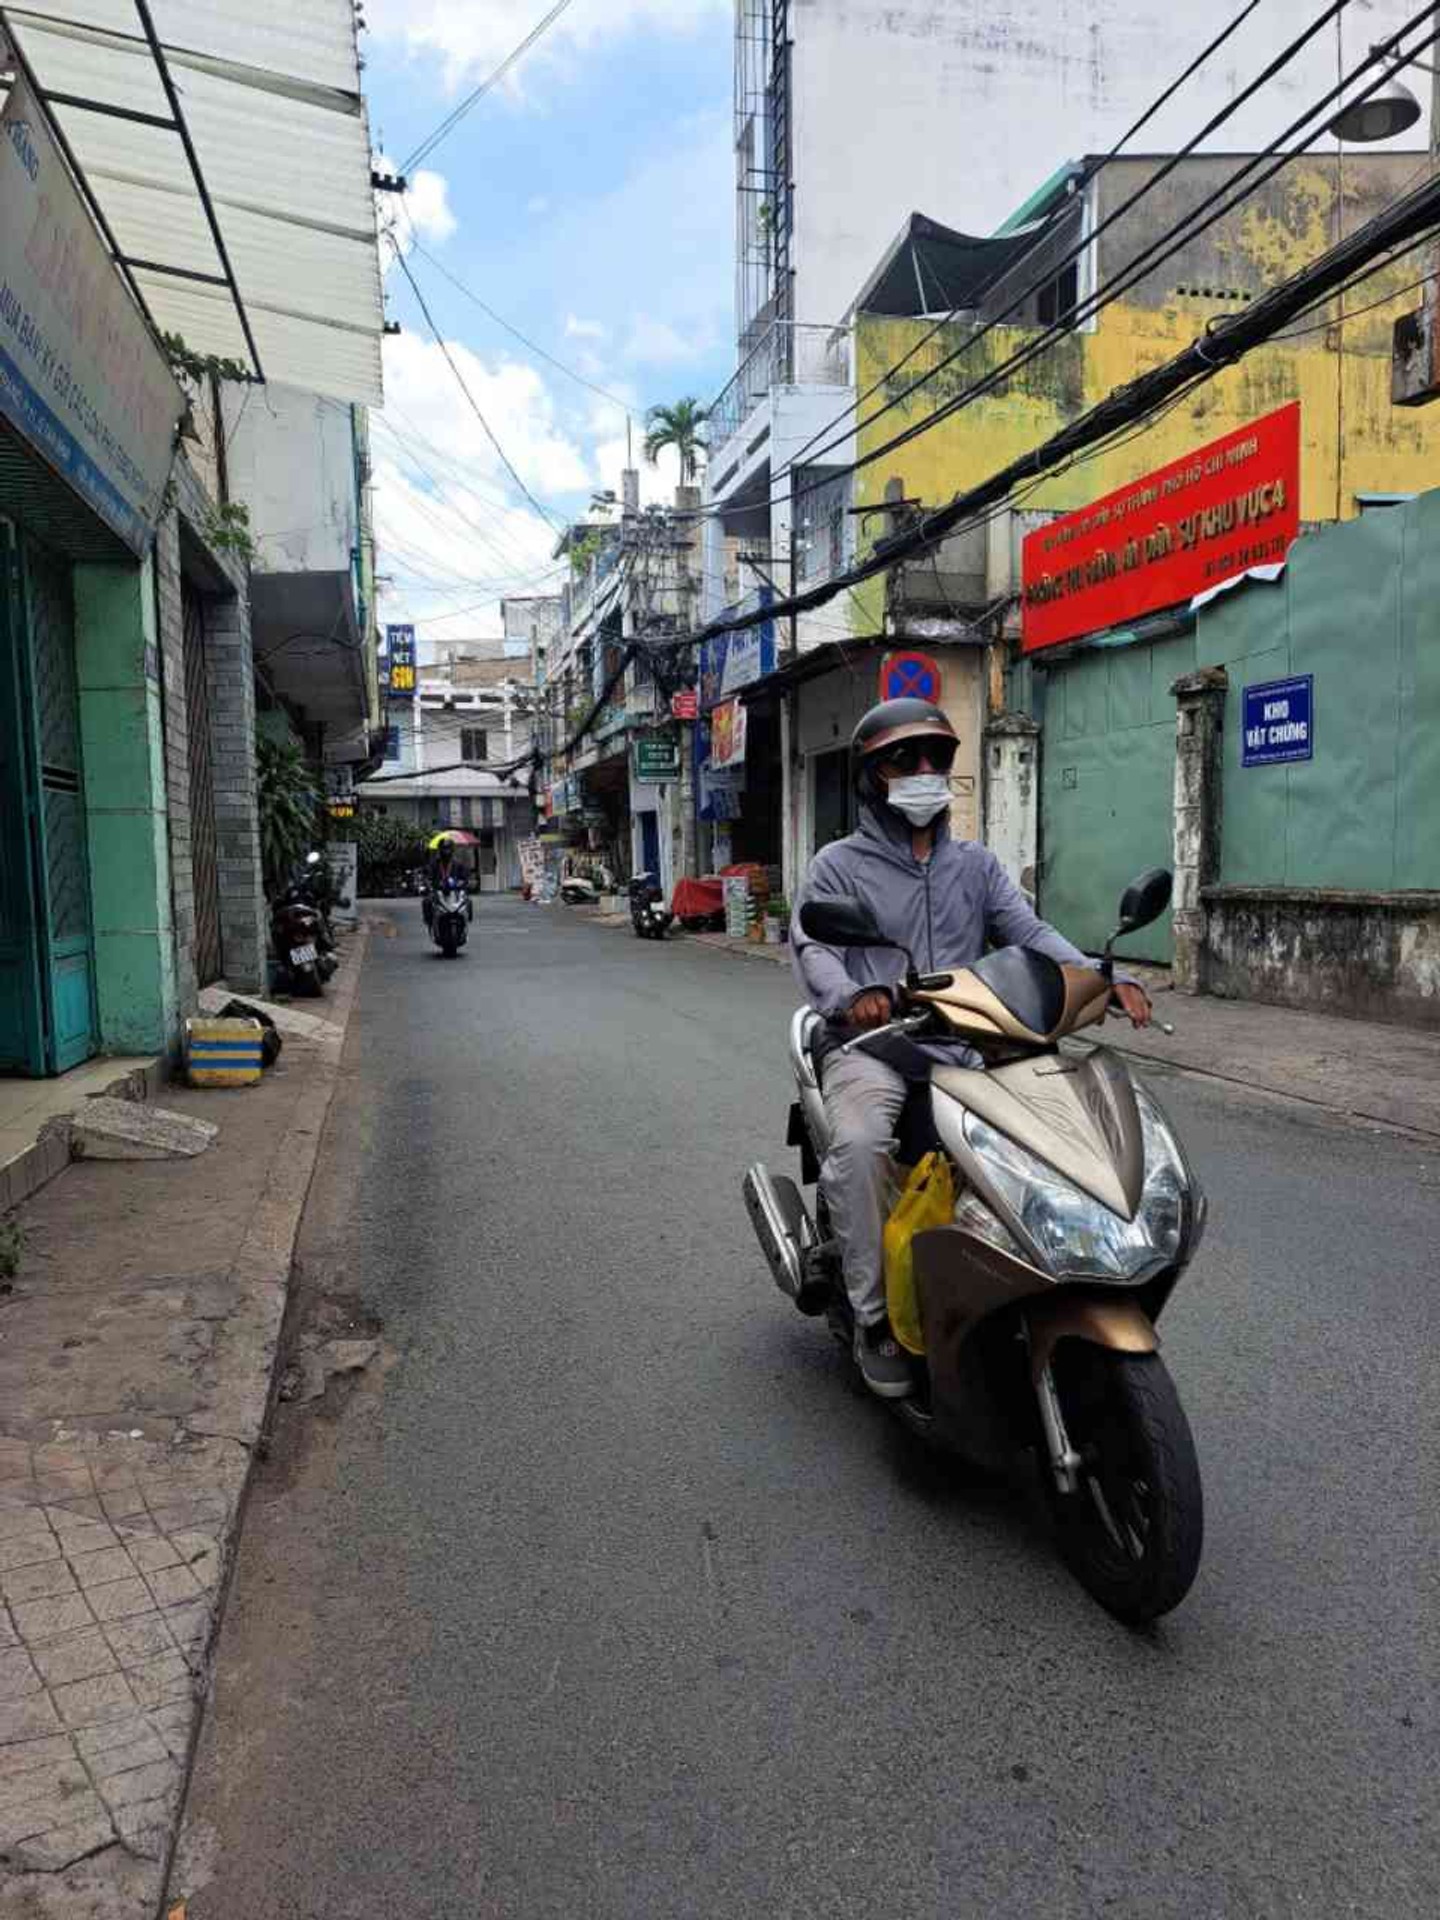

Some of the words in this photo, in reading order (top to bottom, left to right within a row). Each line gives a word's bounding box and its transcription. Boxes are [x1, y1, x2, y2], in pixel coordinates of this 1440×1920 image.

[1200, 500, 1235, 540] KHU
[1271, 477, 1287, 511] 4
[1264, 699, 1290, 721] KHO
[1246, 725, 1267, 751] VẬT
[1268, 720, 1308, 745] CHỨNG
